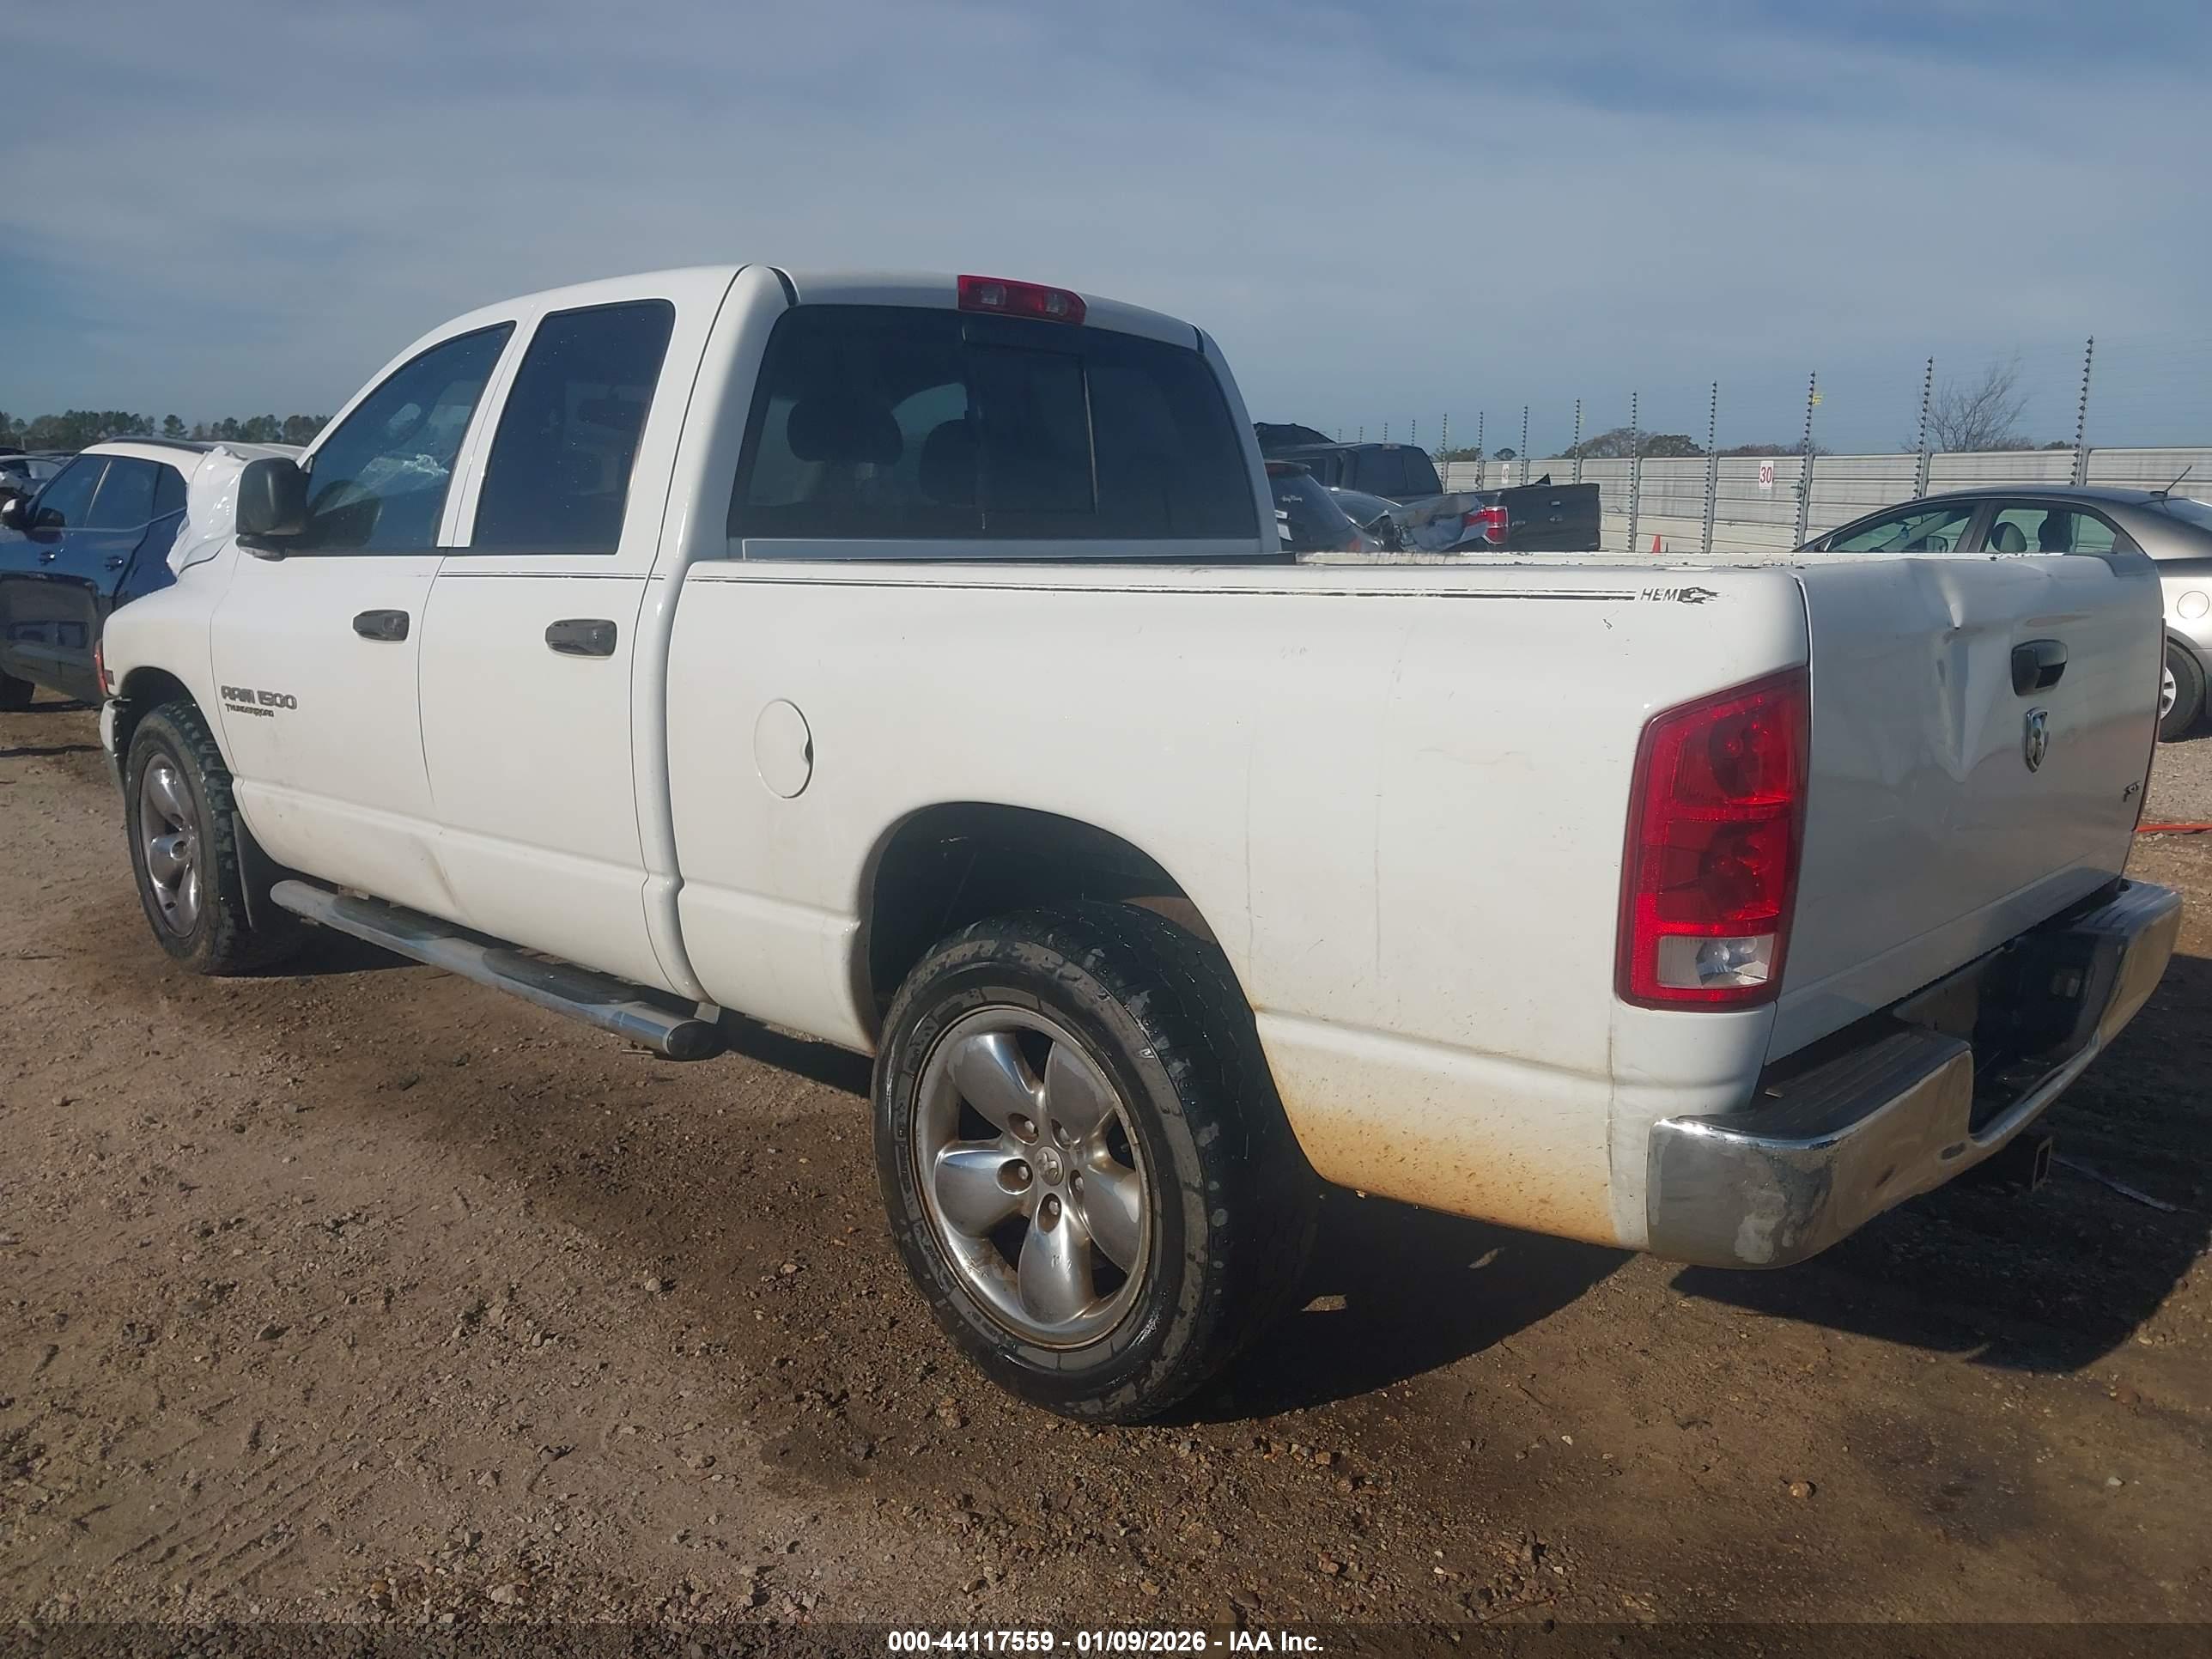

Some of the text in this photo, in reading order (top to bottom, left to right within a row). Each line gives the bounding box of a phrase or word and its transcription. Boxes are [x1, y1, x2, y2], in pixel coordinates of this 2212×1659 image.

[1760, 466, 1772, 483] 30
[221, 685, 297, 710] RAM 1500
